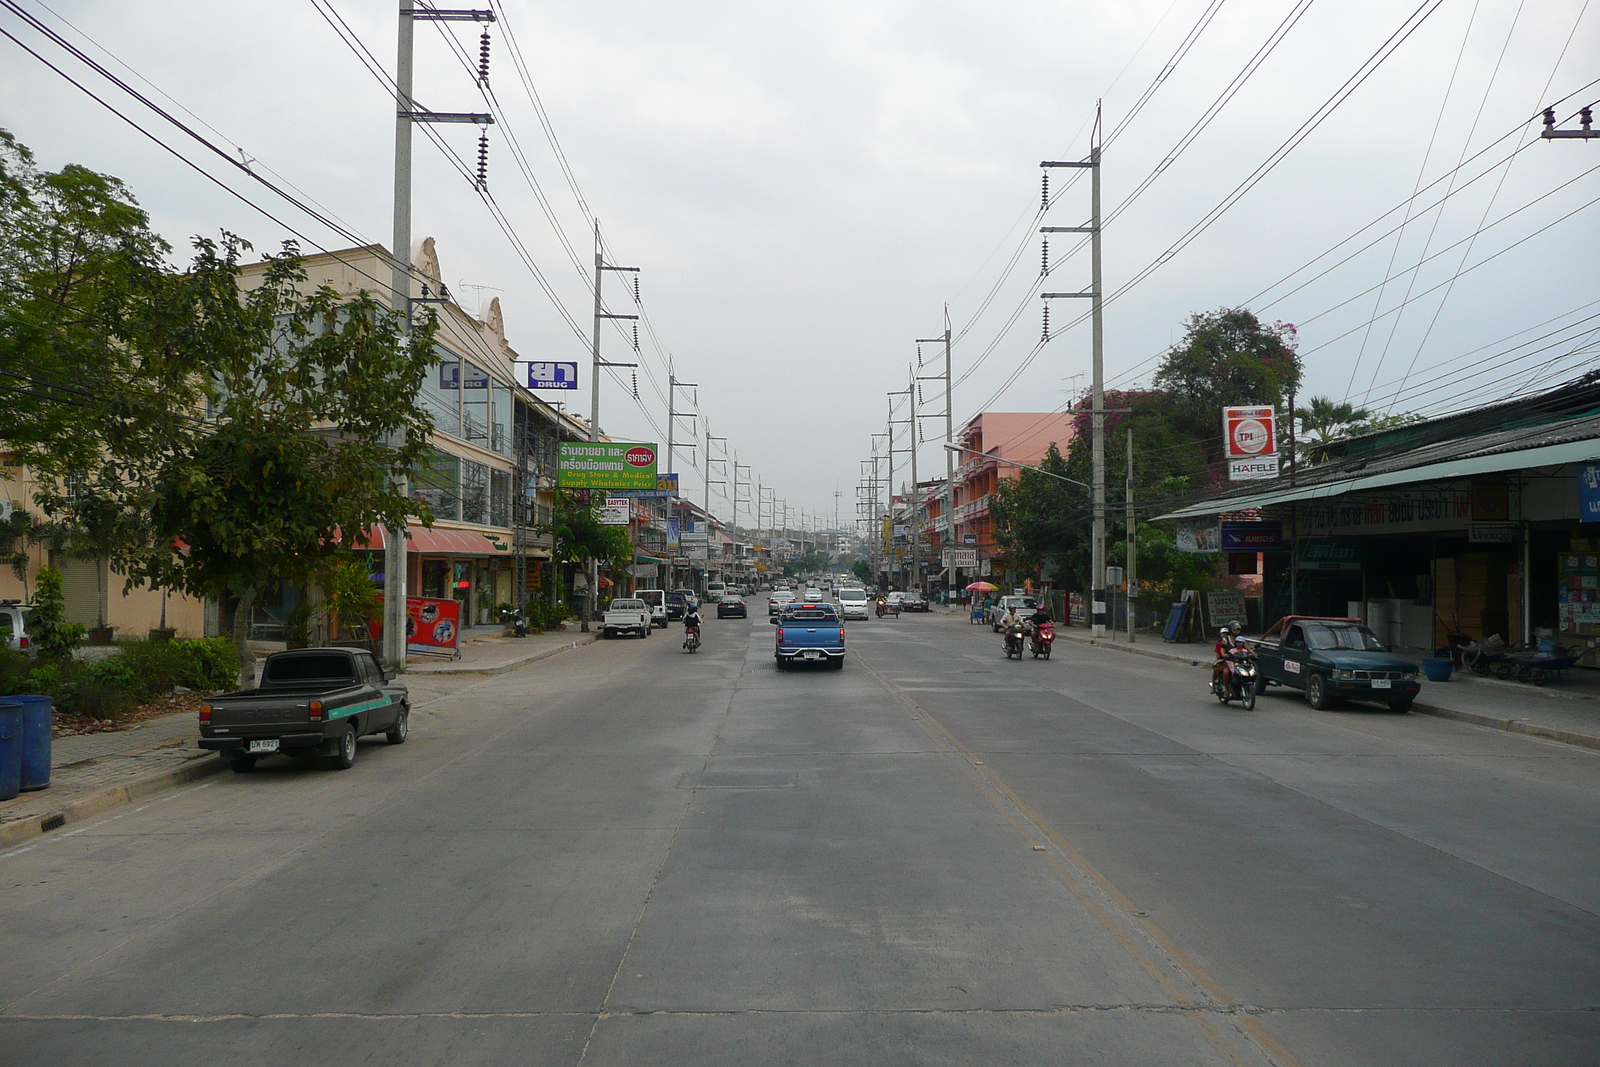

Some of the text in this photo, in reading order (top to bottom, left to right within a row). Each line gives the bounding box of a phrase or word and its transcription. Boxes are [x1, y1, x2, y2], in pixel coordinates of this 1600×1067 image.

[531, 362, 575, 382] ยา
[1239, 433, 1252, 441] TPI
[561, 443, 624, 457] ร้านขายยา และ
[627, 450, 653, 463] ราคาส่ง
[560, 456, 624, 471] เครื่องมือแพทย์
[567, 471, 586, 479] Drug
[622, 471, 653, 479] Medical
[561, 479, 588, 487] Supply
[633, 480, 653, 488] Price
